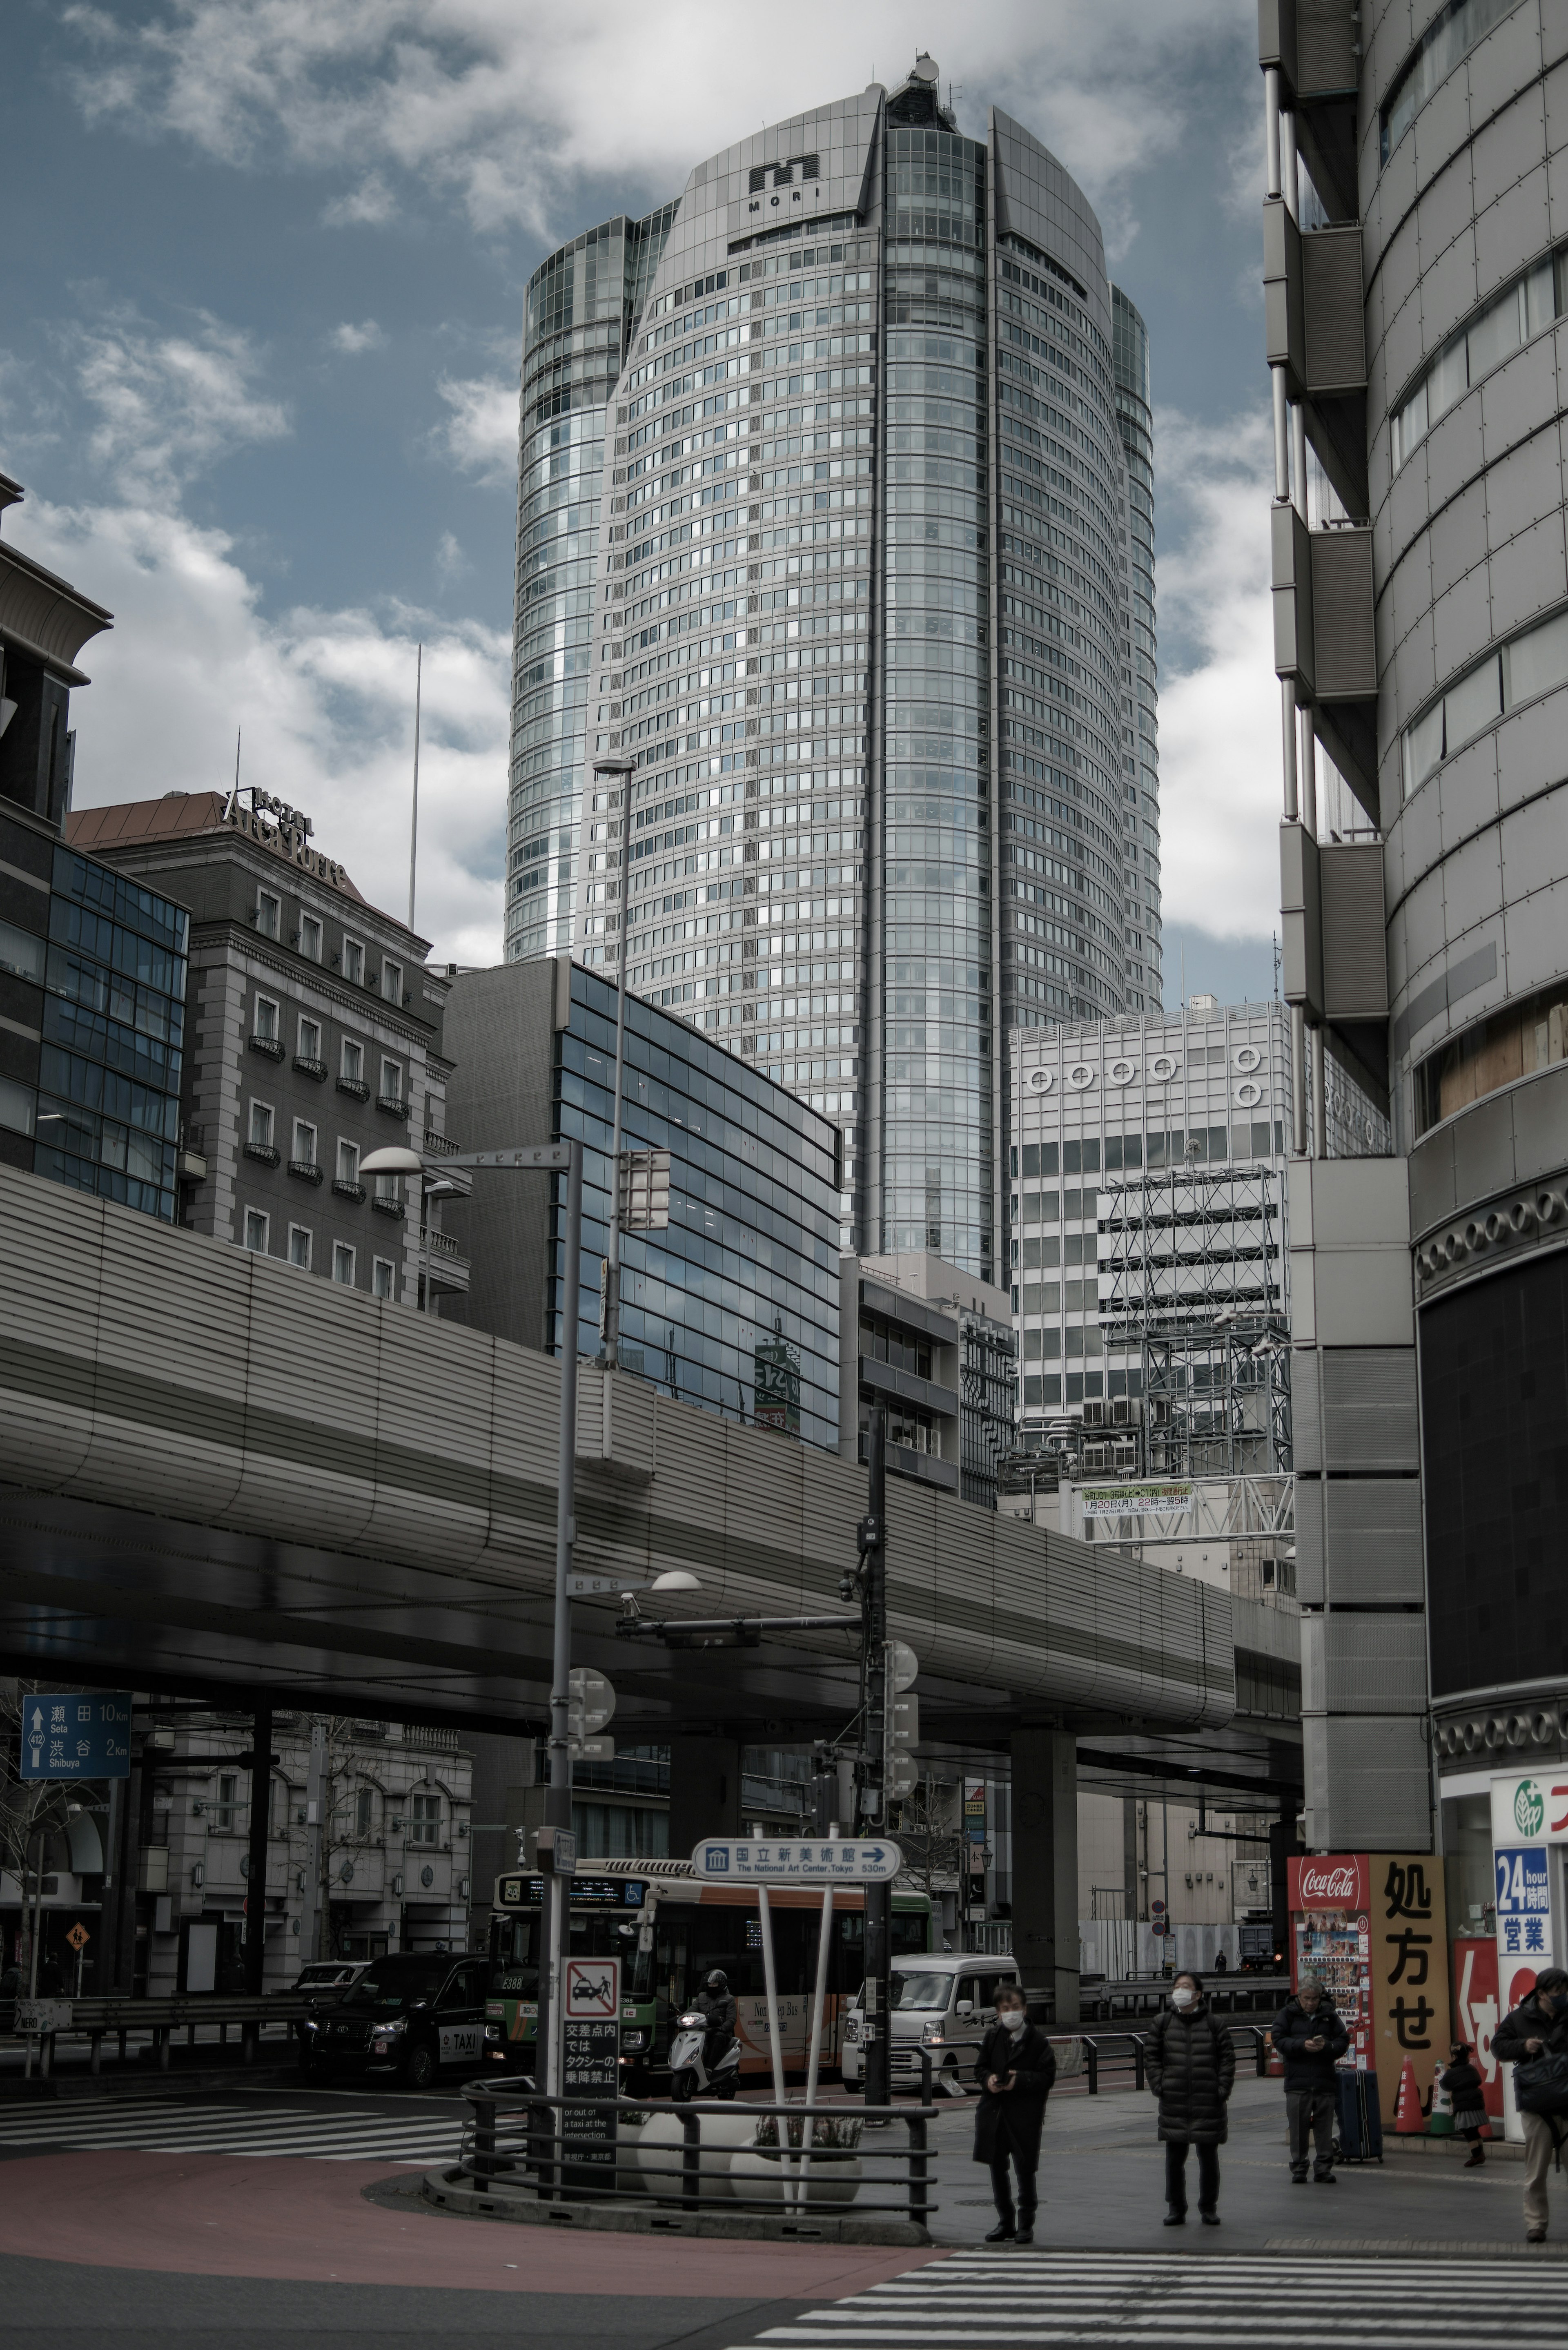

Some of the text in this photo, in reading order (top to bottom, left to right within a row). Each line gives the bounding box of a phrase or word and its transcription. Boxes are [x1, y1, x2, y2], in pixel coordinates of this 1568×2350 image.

[749, 187, 819, 212] MORI
[255, 787, 314, 836] HOTEL
[1085, 1490, 1107, 1500] 谷町JCT
[1162, 1487, 1188, 1496] 夜間通行止
[1085, 1499, 1133, 1509] 1月20日(月)
[50, 1705, 91, 1722] 瀬田
[50, 1724, 68, 1733] Seta
[31, 1735, 42, 1744] 412
[49, 1739, 91, 1757] 渋谷
[49, 1758, 80, 1769] Shibuya
[736, 1847, 855, 1862] 国立新美術館
[737, 1864, 751, 1872] The
[754, 1864, 785, 1872] National
[788, 1864, 799, 1872] Art
[862, 1864, 886, 1873] 530m
[1303, 1867, 1356, 1898] Coca-Cola
[1497, 1855, 1547, 1911] 24 hour
[1527, 1886, 1548, 1910] 時間
[1504, 1917, 1544, 1952] 営業
[503, 1978, 522, 1990] E388
[755, 2002, 767, 2016] Non
[787, 2002, 798, 2016] Bus
[21, 2018, 38, 2029] NERO
[566, 2023, 616, 2037] 交差点内
[454, 2033, 475, 2049] TAXI
[566, 2040, 590, 2052] では
[566, 2055, 615, 2068] タクシーの
[565, 2070, 615, 2084] 乗降禁止
[570, 2119, 584, 2128] taxi
[594, 2118, 607, 2127] the
[564, 2130, 606, 2139] intersection
